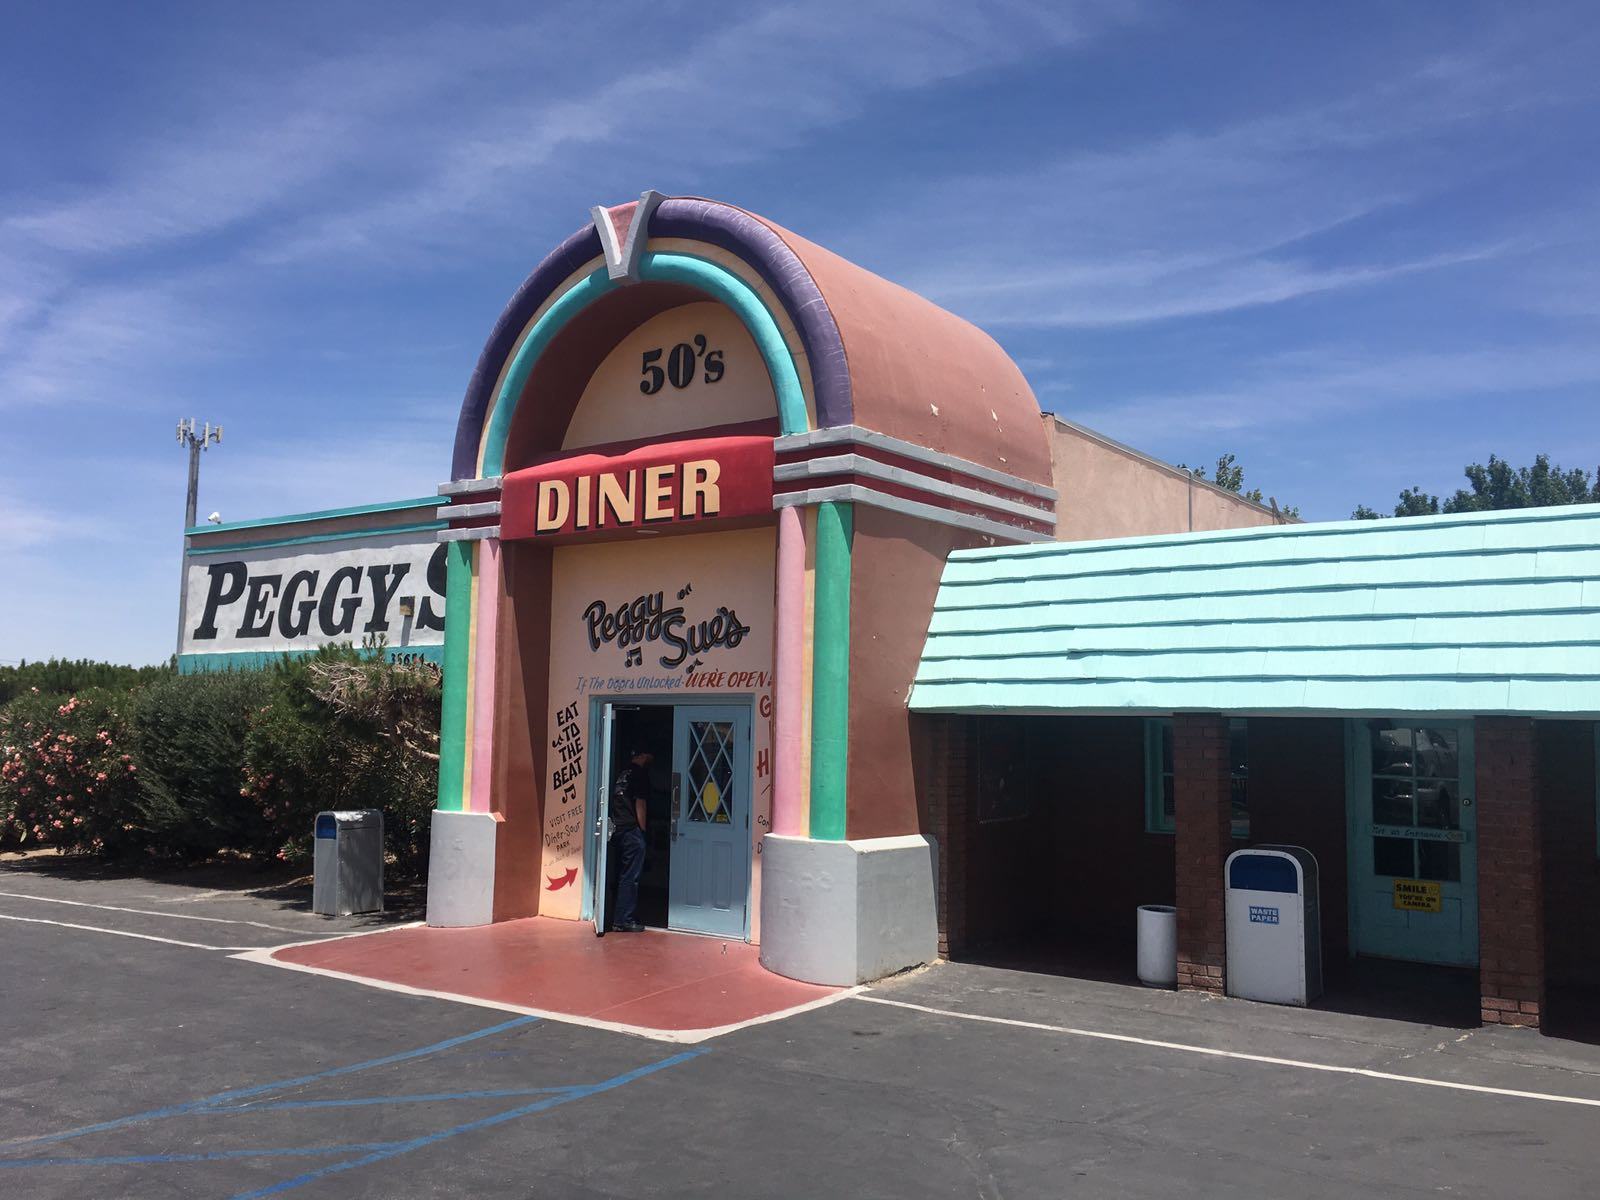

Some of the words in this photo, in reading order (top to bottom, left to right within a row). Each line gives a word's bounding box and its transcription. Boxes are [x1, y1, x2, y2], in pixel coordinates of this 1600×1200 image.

[639, 334, 725, 395] 50's
[535, 459, 721, 535] DINER
[193, 561, 411, 640] PEGGY
[582, 590, 684, 651] Peggy
[660, 606, 751, 669] Sue's
[576, 676, 588, 695] If
[589, 675, 605, 690] The
[556, 700, 579, 727] EAT
[561, 722, 581, 742] TO
[558, 736, 584, 763] THE
[553, 755, 583, 791] BEAT
[549, 813, 566, 828] VISIT
[567, 804, 583, 819] FREE
[1396, 883, 1428, 894] SMILE
[1250, 907, 1278, 915] WASTE
[1251, 914, 1278, 922] PAPER
